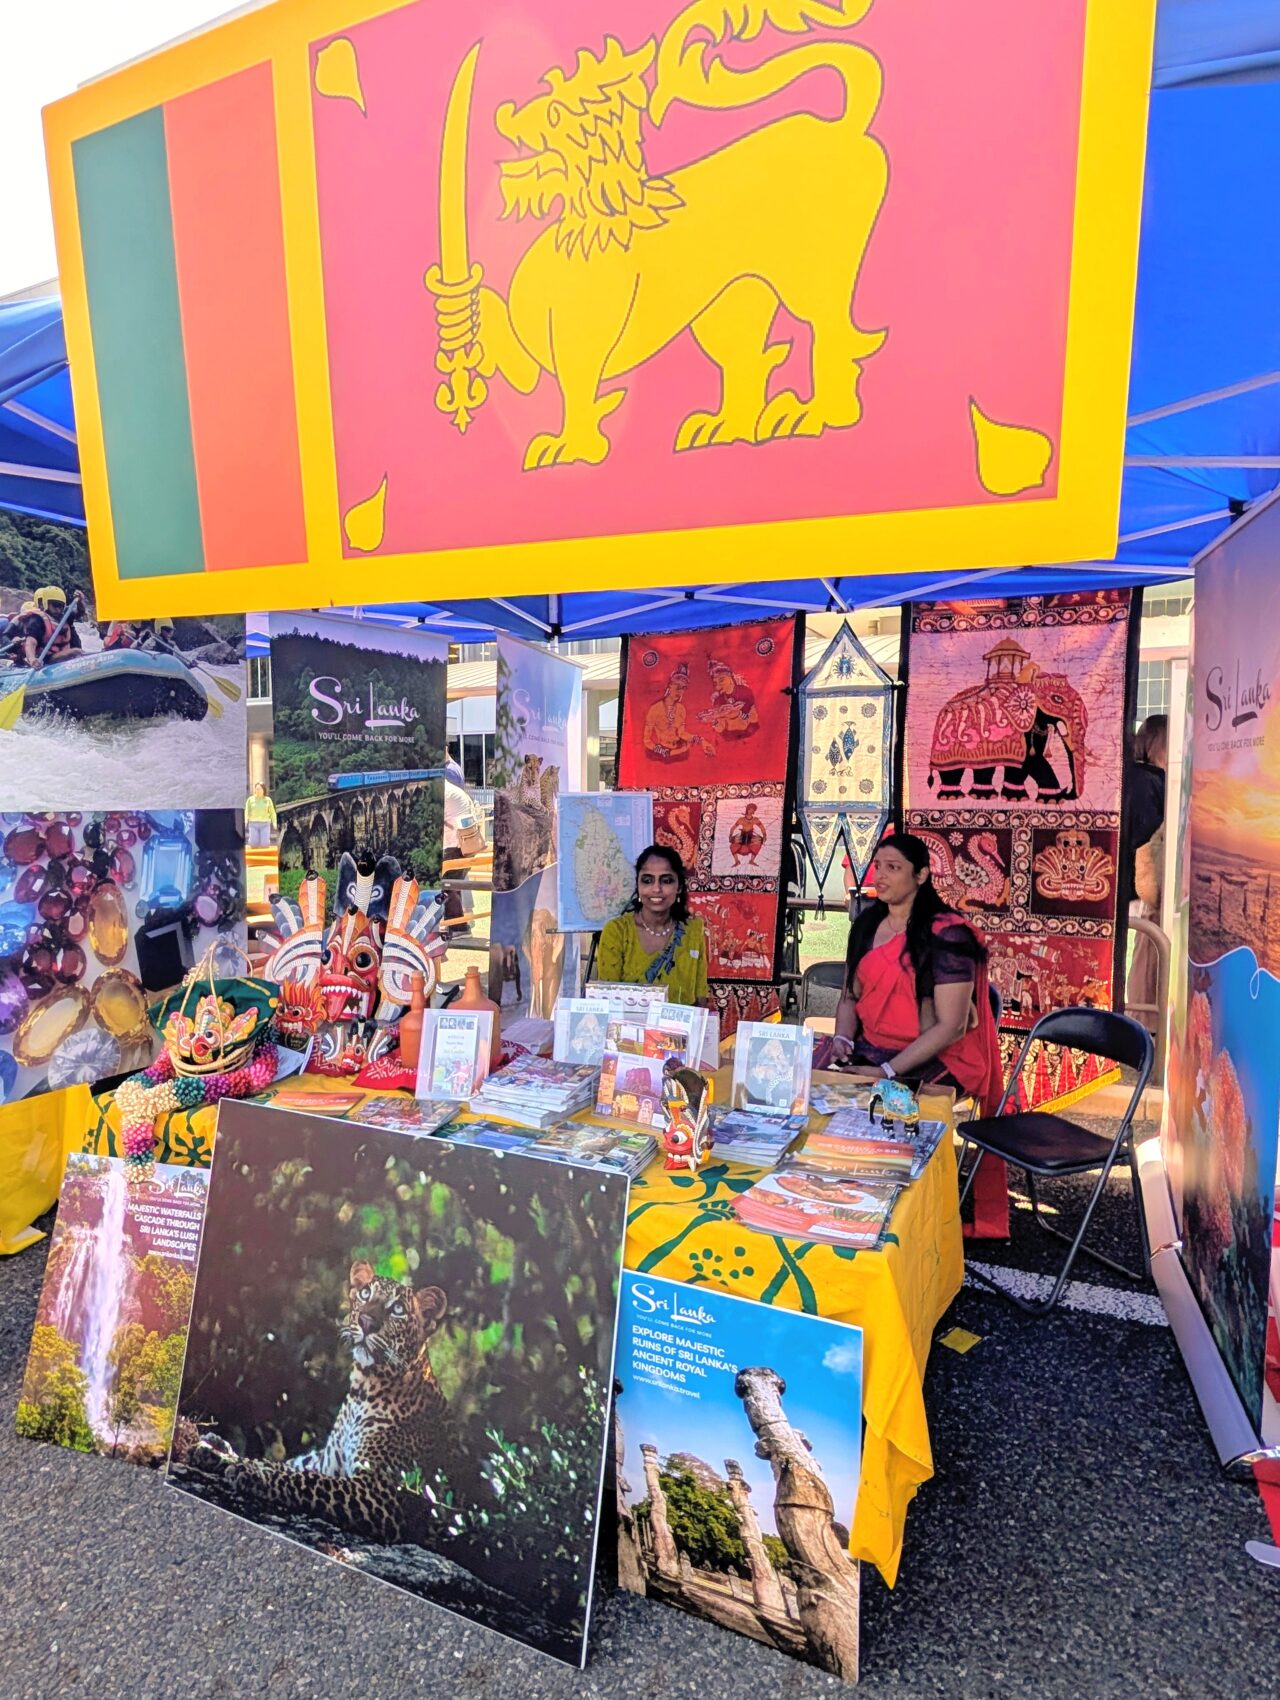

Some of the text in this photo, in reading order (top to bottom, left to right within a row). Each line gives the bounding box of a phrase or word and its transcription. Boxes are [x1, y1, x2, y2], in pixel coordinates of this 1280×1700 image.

[309, 676, 421, 731] Sri Lanka
[1206, 657, 1272, 733] Sri Lanka
[318, 732, 415, 744] YOU'LL COME BACK FOR MORE
[758, 1030, 790, 1040] SRI LANKA
[805, 1158, 902, 1177] Sri Lanka
[174, 1175, 206, 1198] Lanka
[128, 1202, 202, 1221] MAJESTIC WATERFALLS
[134, 1214, 200, 1231] CASCADE THROUGH
[139, 1225, 198, 1241] SRI LANKA'S LUSH
[152, 1237, 197, 1251] LANDSCAPES
[631, 1282, 716, 1325] Sri Lanka
[632, 1324, 725, 1358] EXPLORE MAJESTIC
[632, 1336, 739, 1374] RUINS OF SRI LANKA'S
[632, 1348, 708, 1378] ANCIENT ROYAL
[632, 1360, 687, 1383] KINGDOMS
